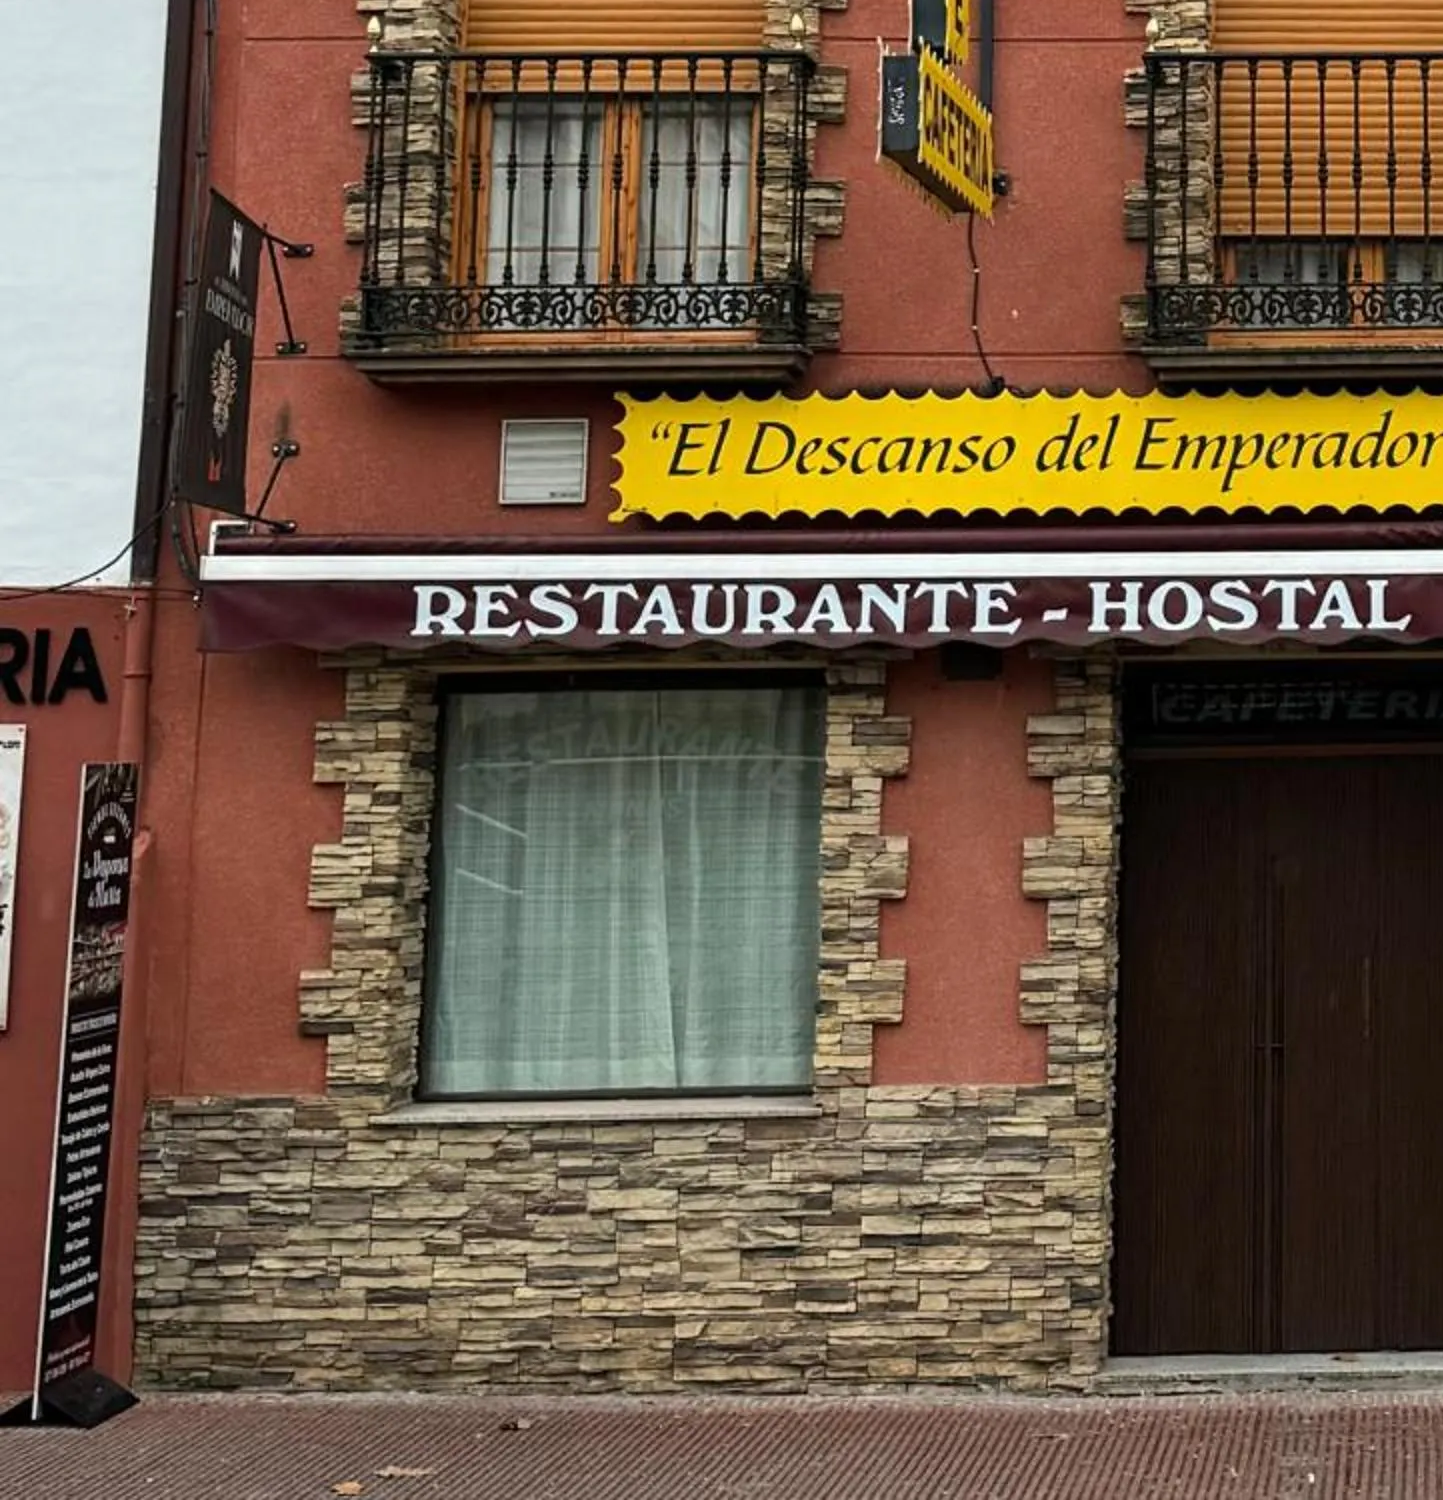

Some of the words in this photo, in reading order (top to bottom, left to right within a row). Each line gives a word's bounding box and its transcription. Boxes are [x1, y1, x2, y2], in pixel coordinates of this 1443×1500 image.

[744, 420, 1017, 476] Descanso
[1035, 412, 1121, 473] del
[410, 580, 1023, 637] RESTAURANTE
[1087, 579, 1413, 632] HOSTAL
